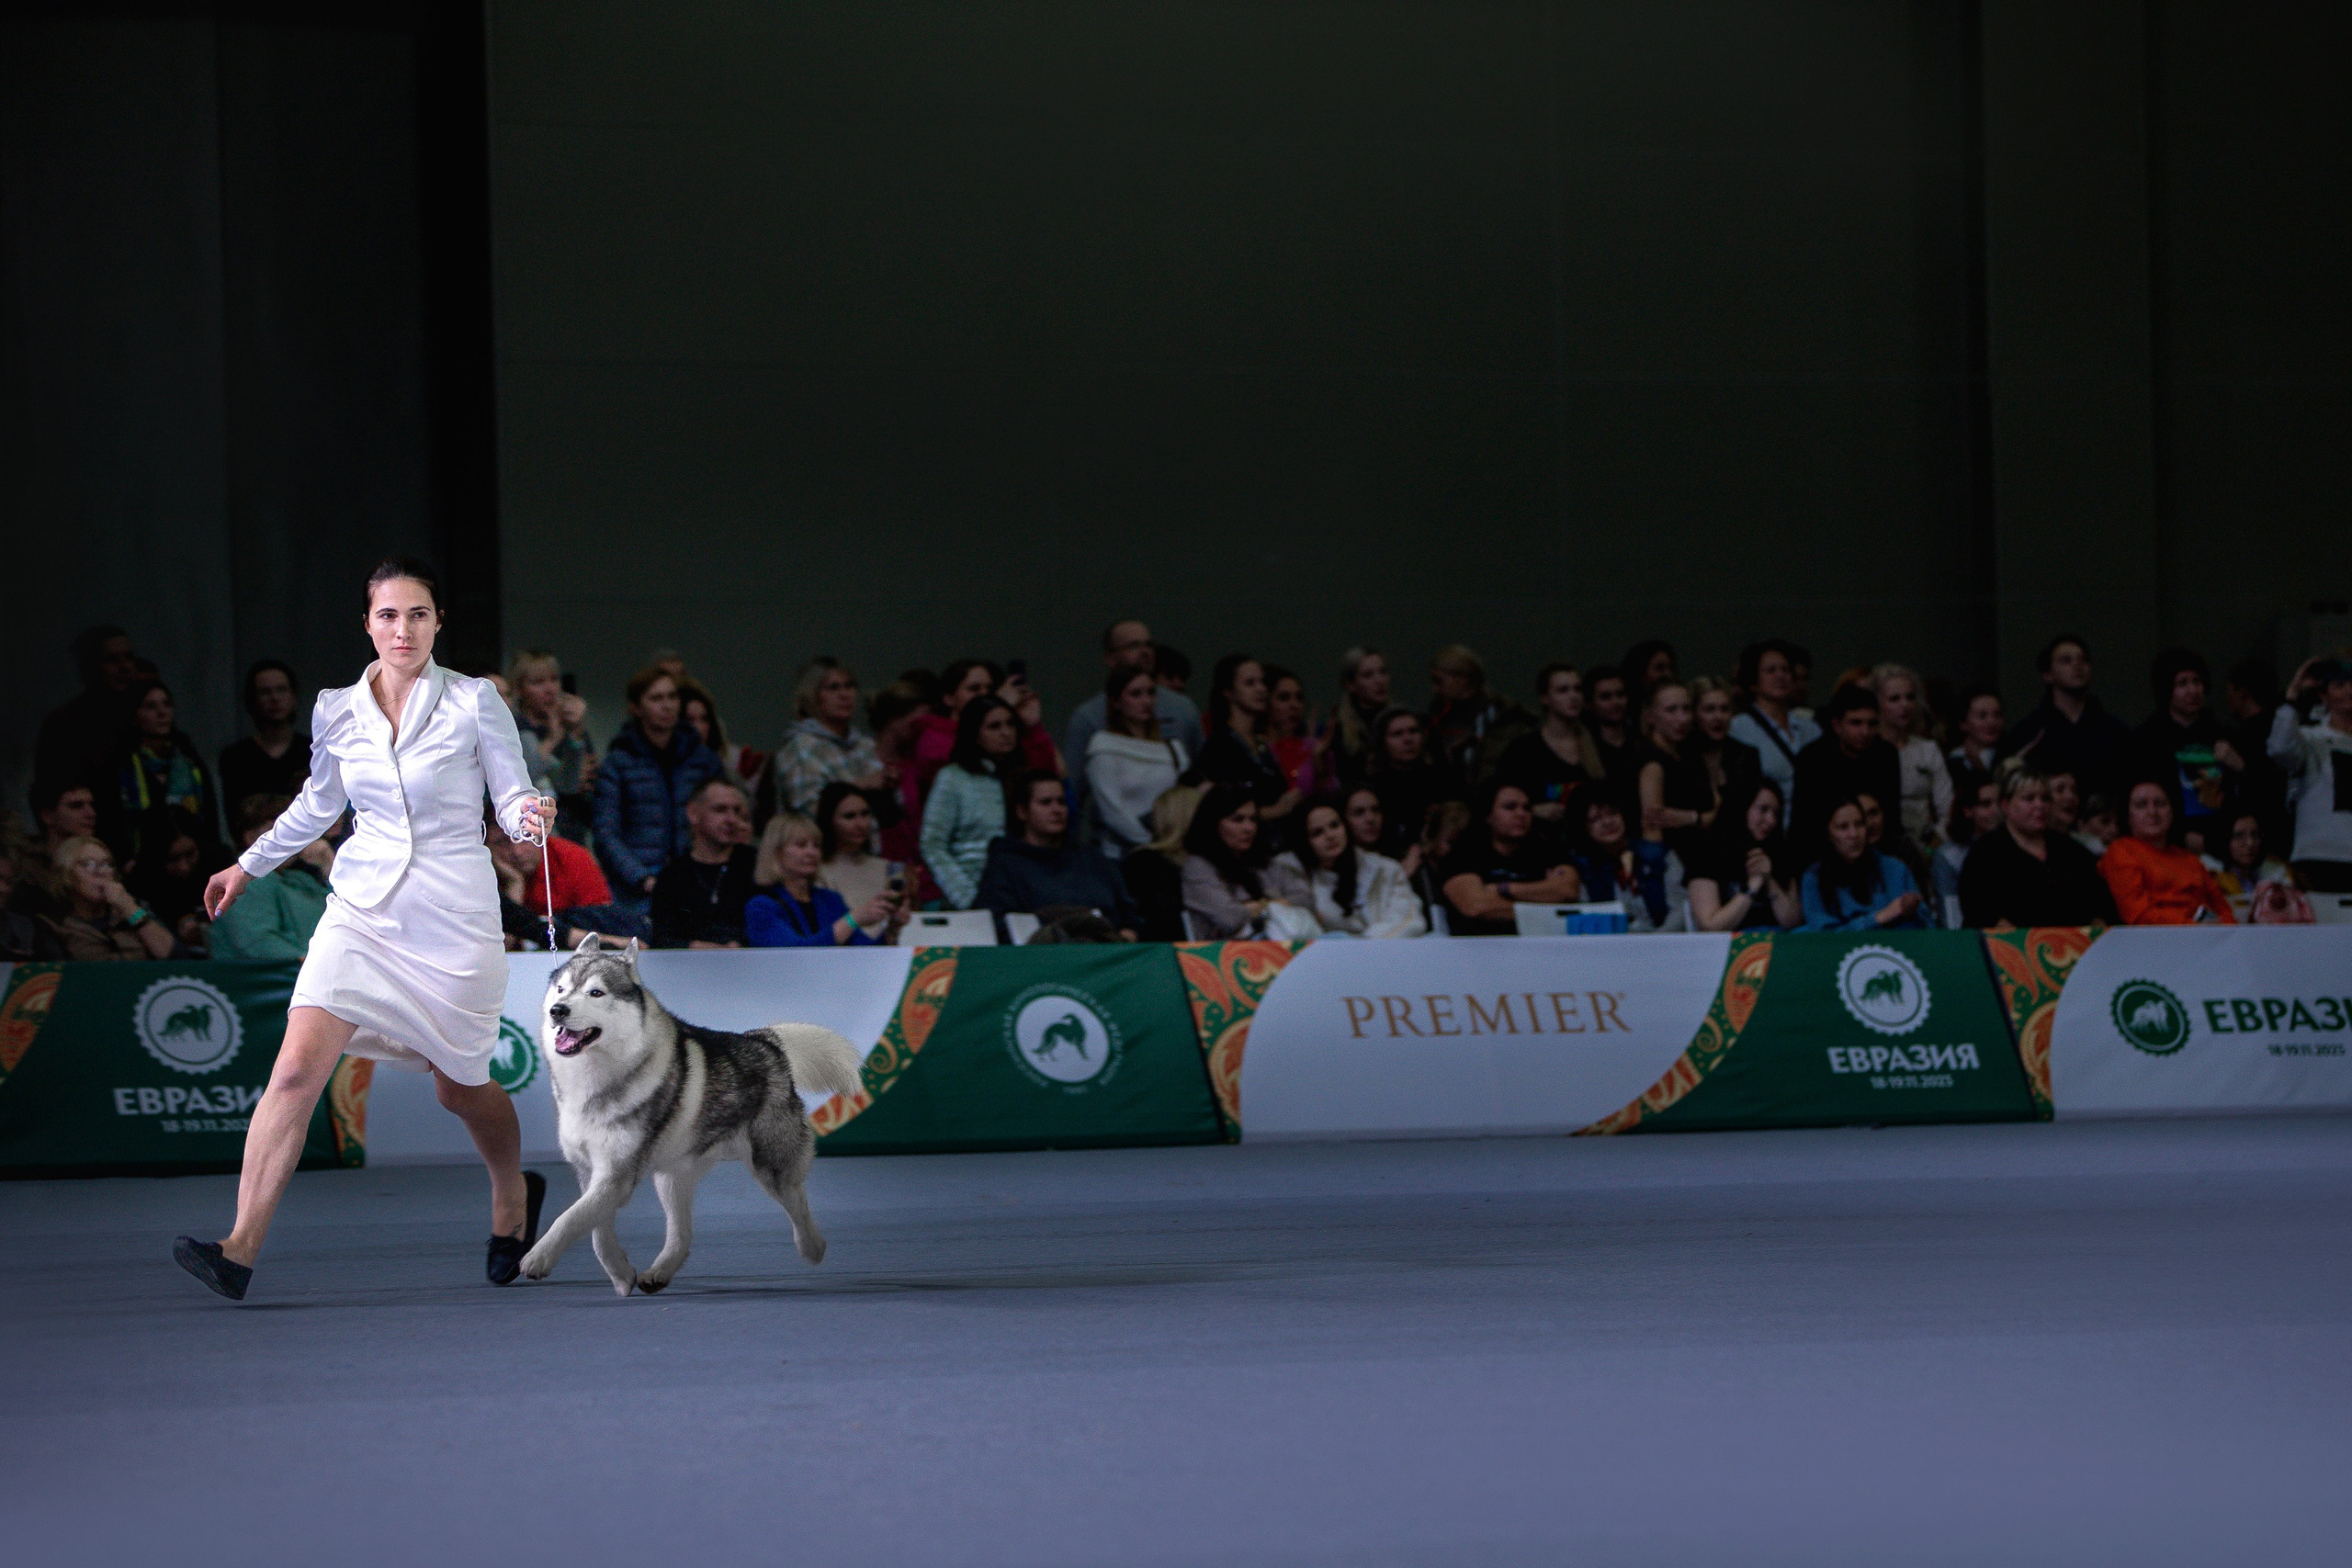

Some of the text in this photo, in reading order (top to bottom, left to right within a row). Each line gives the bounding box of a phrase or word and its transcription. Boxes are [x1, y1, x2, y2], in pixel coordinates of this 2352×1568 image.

[1341, 991, 1631, 1038] PREMIER
[2203, 997, 2352, 1032] ЕВРАЗ
[1827, 1043, 1980, 1073] ЕВРАЗИЯ
[114, 1085, 264, 1115] ЕВРАЗИ
